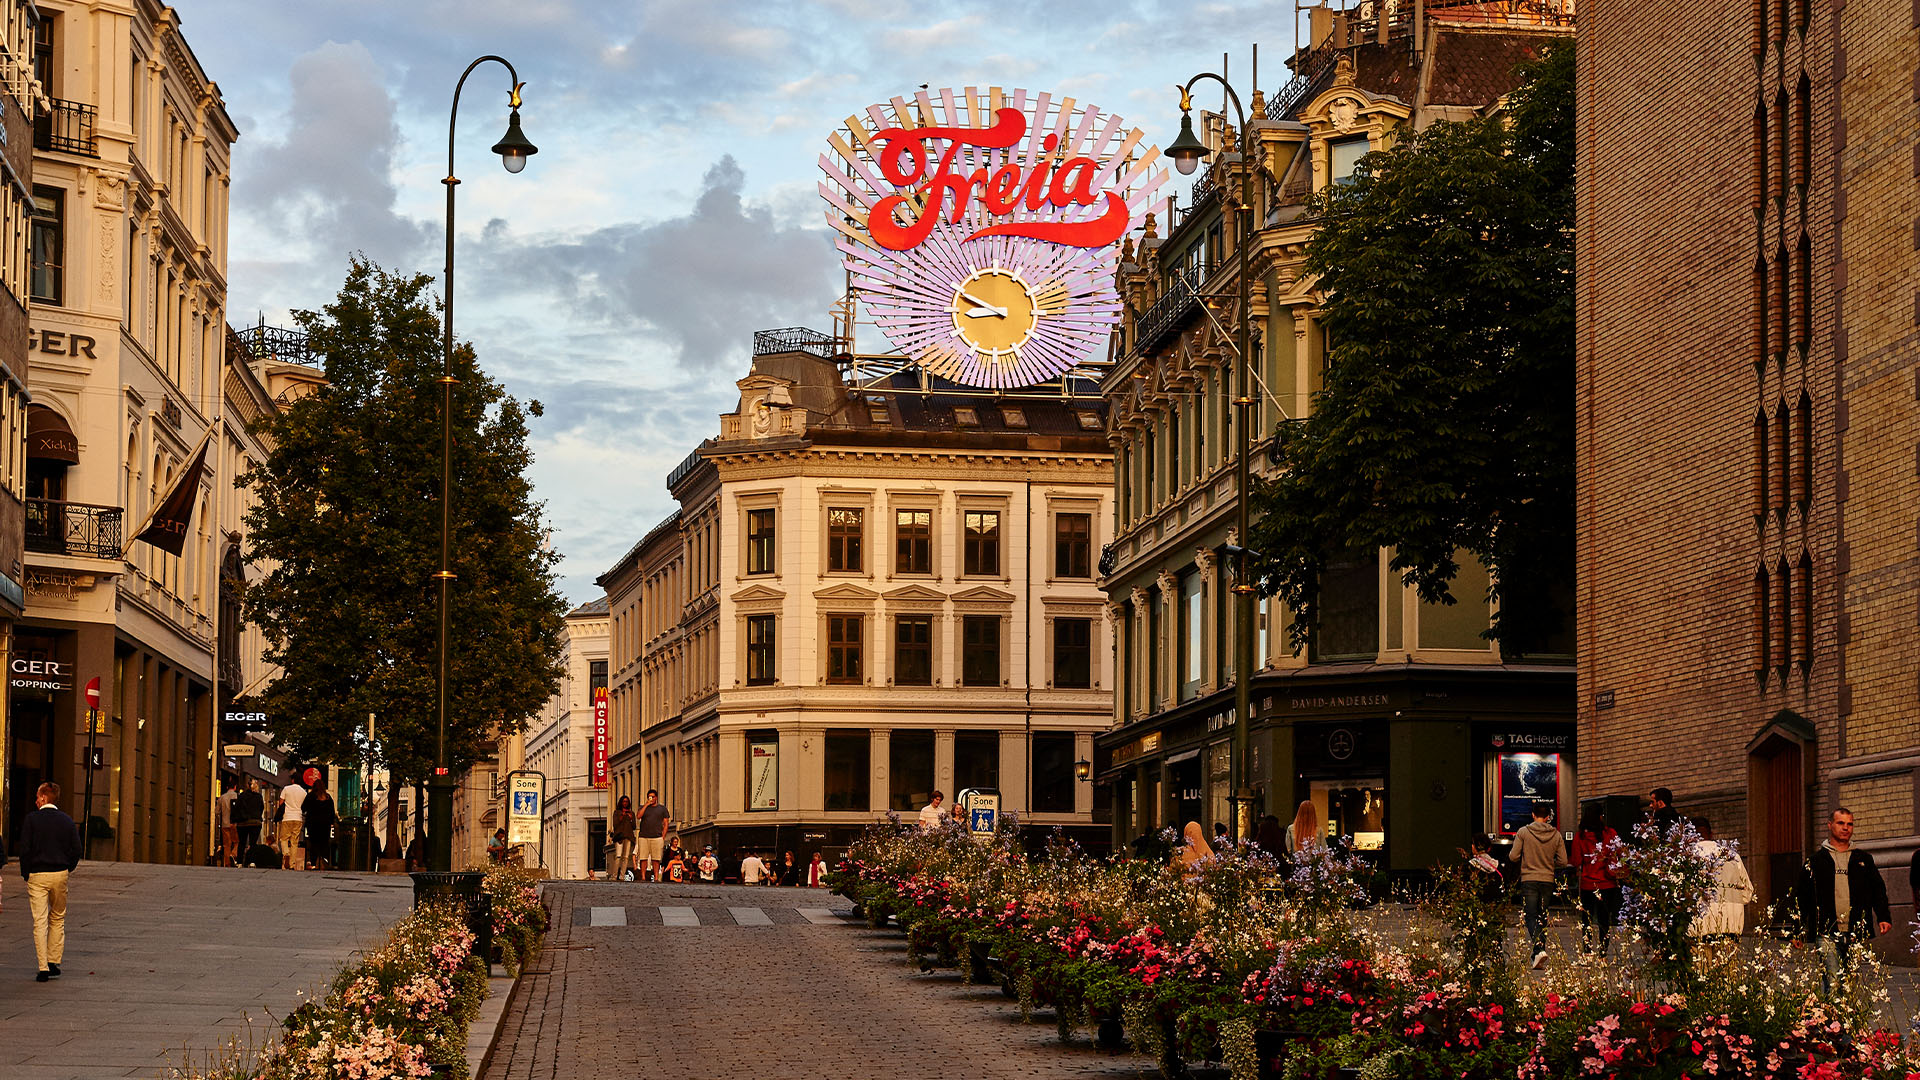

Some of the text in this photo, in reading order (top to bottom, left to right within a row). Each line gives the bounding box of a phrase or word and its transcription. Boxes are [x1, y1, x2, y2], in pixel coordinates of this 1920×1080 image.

[866, 107, 1129, 251] Freia
[1292, 694, 1389, 709] DAVID-ANDERSEN
[225, 712, 267, 721] EGER
[595, 701, 606, 777] McDonald's
[516, 780, 537, 789] Sone
[973, 797, 993, 806] Sone
